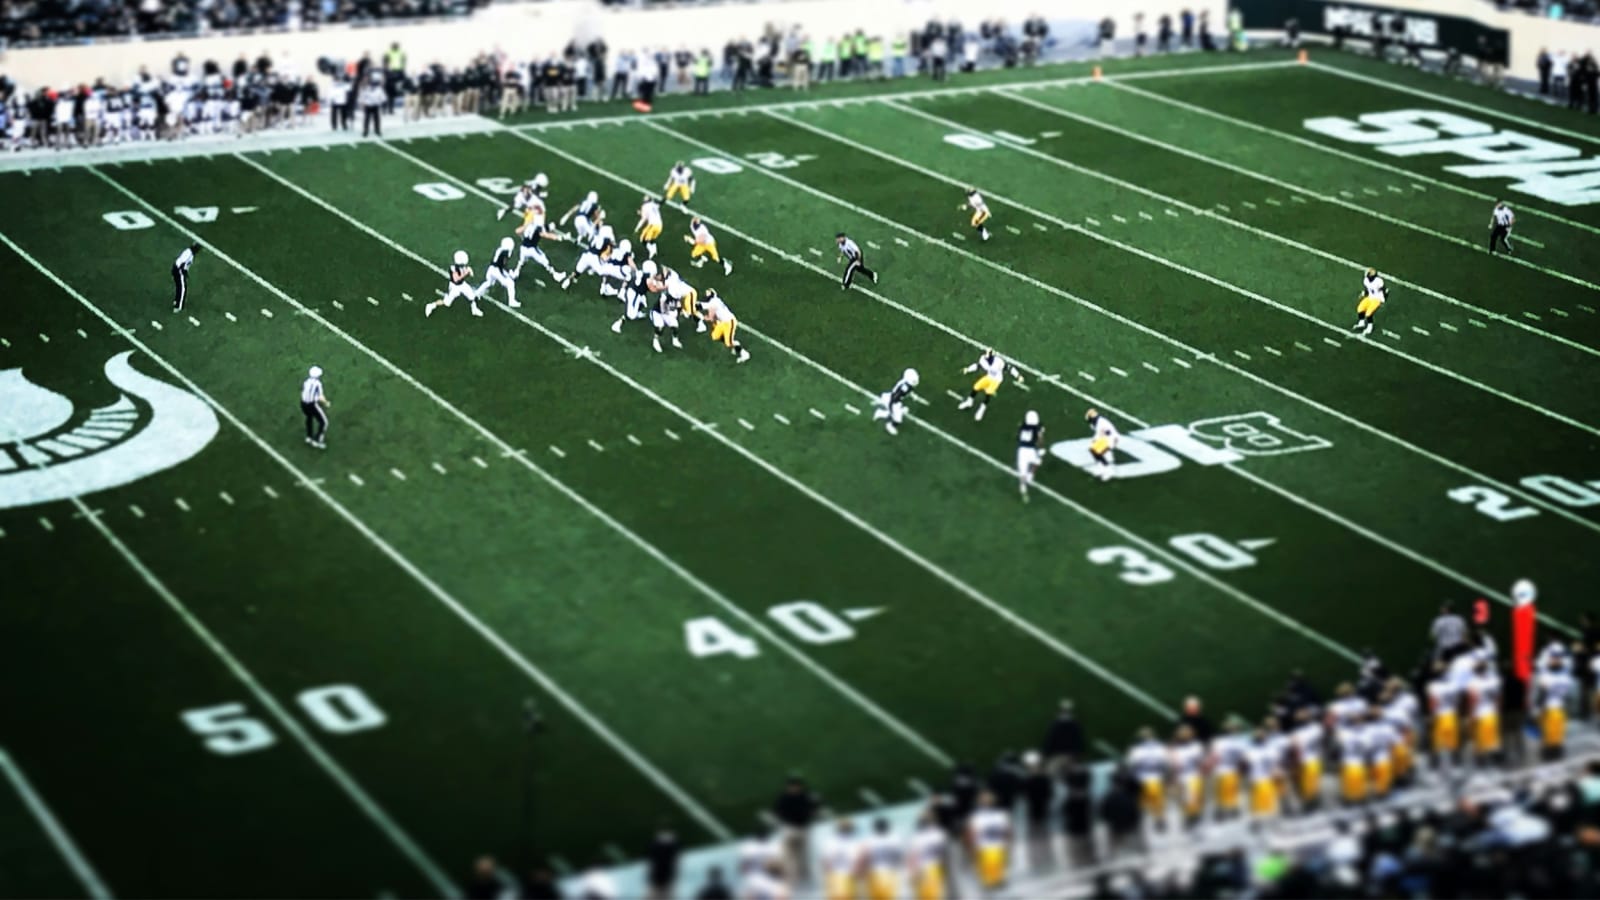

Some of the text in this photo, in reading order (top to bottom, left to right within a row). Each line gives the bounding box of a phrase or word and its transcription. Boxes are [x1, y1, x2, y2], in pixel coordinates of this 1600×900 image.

[691, 152, 799, 174] 20
[1303, 109, 1600, 206] SPA
[103, 204, 220, 230] 40
[1447, 474, 1600, 522] 20
[1087, 532, 1257, 585] 30
[683, 600, 855, 659] 40
[180, 684, 388, 756] 50
